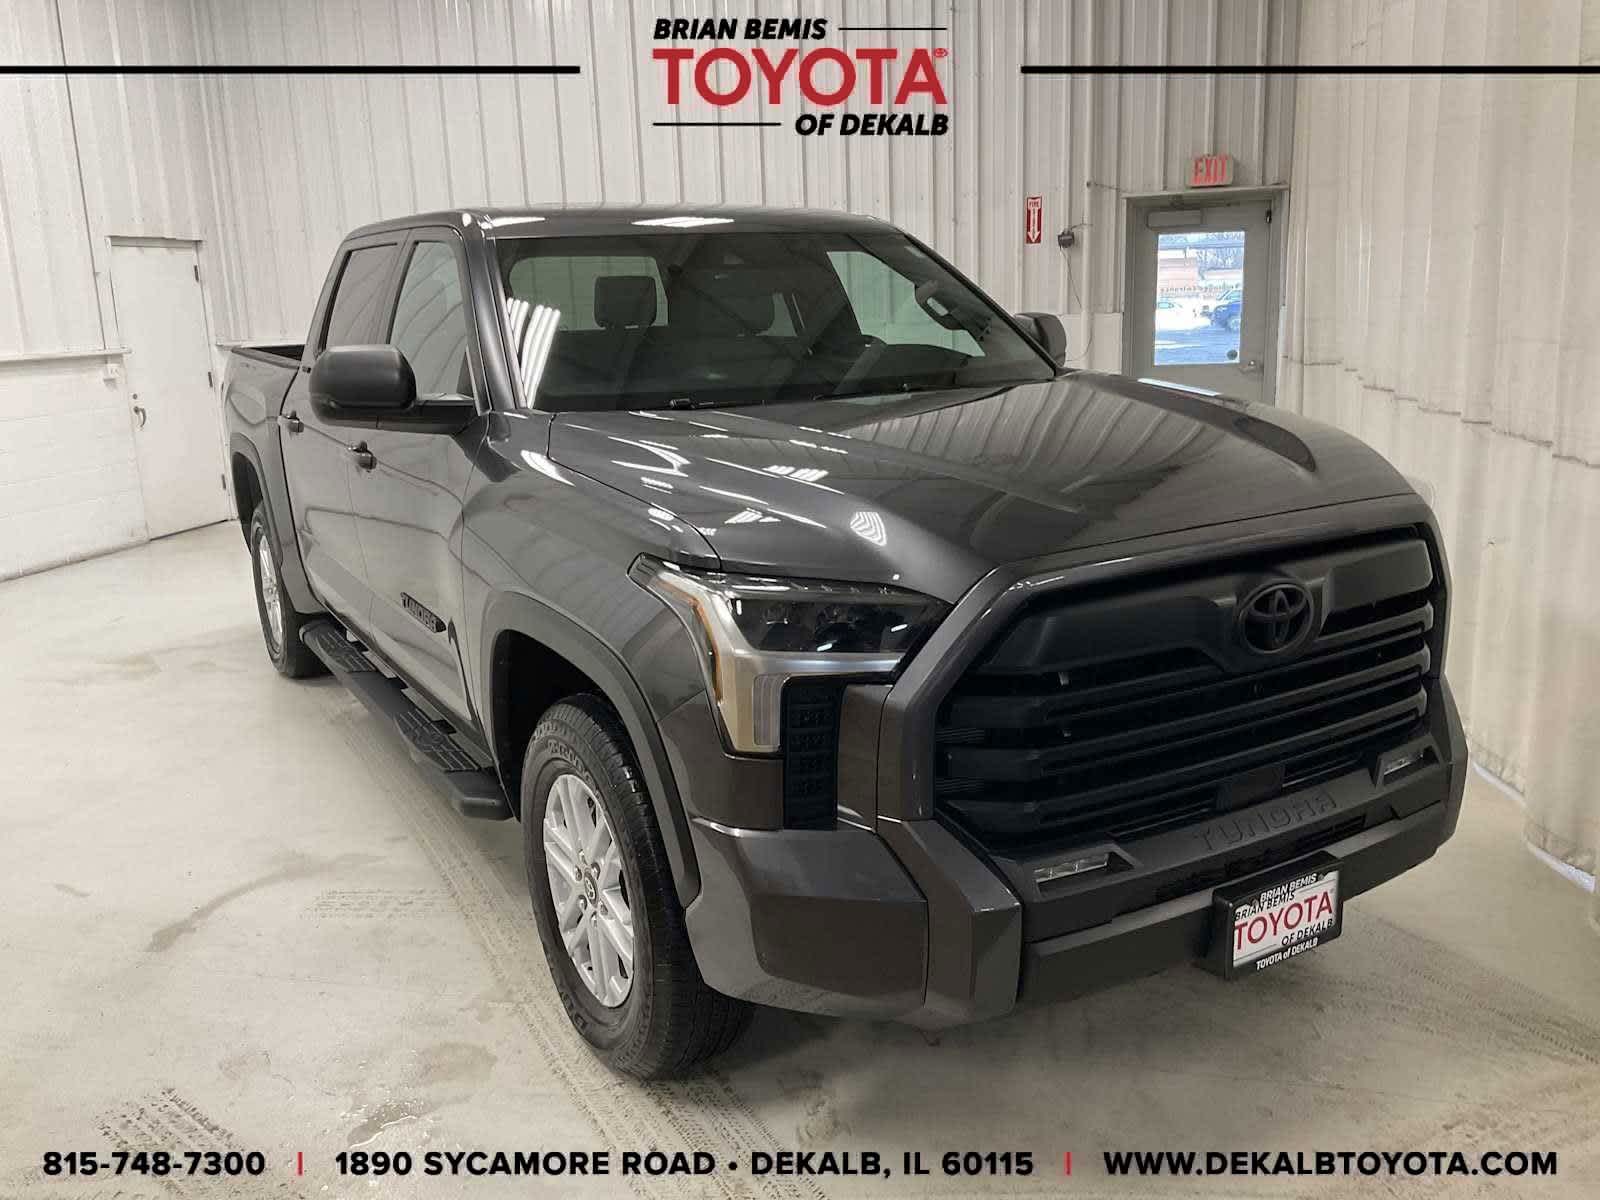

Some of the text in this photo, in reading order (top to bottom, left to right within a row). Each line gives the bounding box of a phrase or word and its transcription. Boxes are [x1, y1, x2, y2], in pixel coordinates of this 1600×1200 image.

[1192, 156, 1228, 184] EXIT
[1195, 786, 1338, 850] TUNDRA
[1260, 873, 1317, 902] BRIAN BEMIS
[1234, 891, 1333, 950] TOYOTA
[1281, 918, 1333, 946] OF DEKALB
[1256, 937, 1319, 971] TOYOTA of DEKALB
